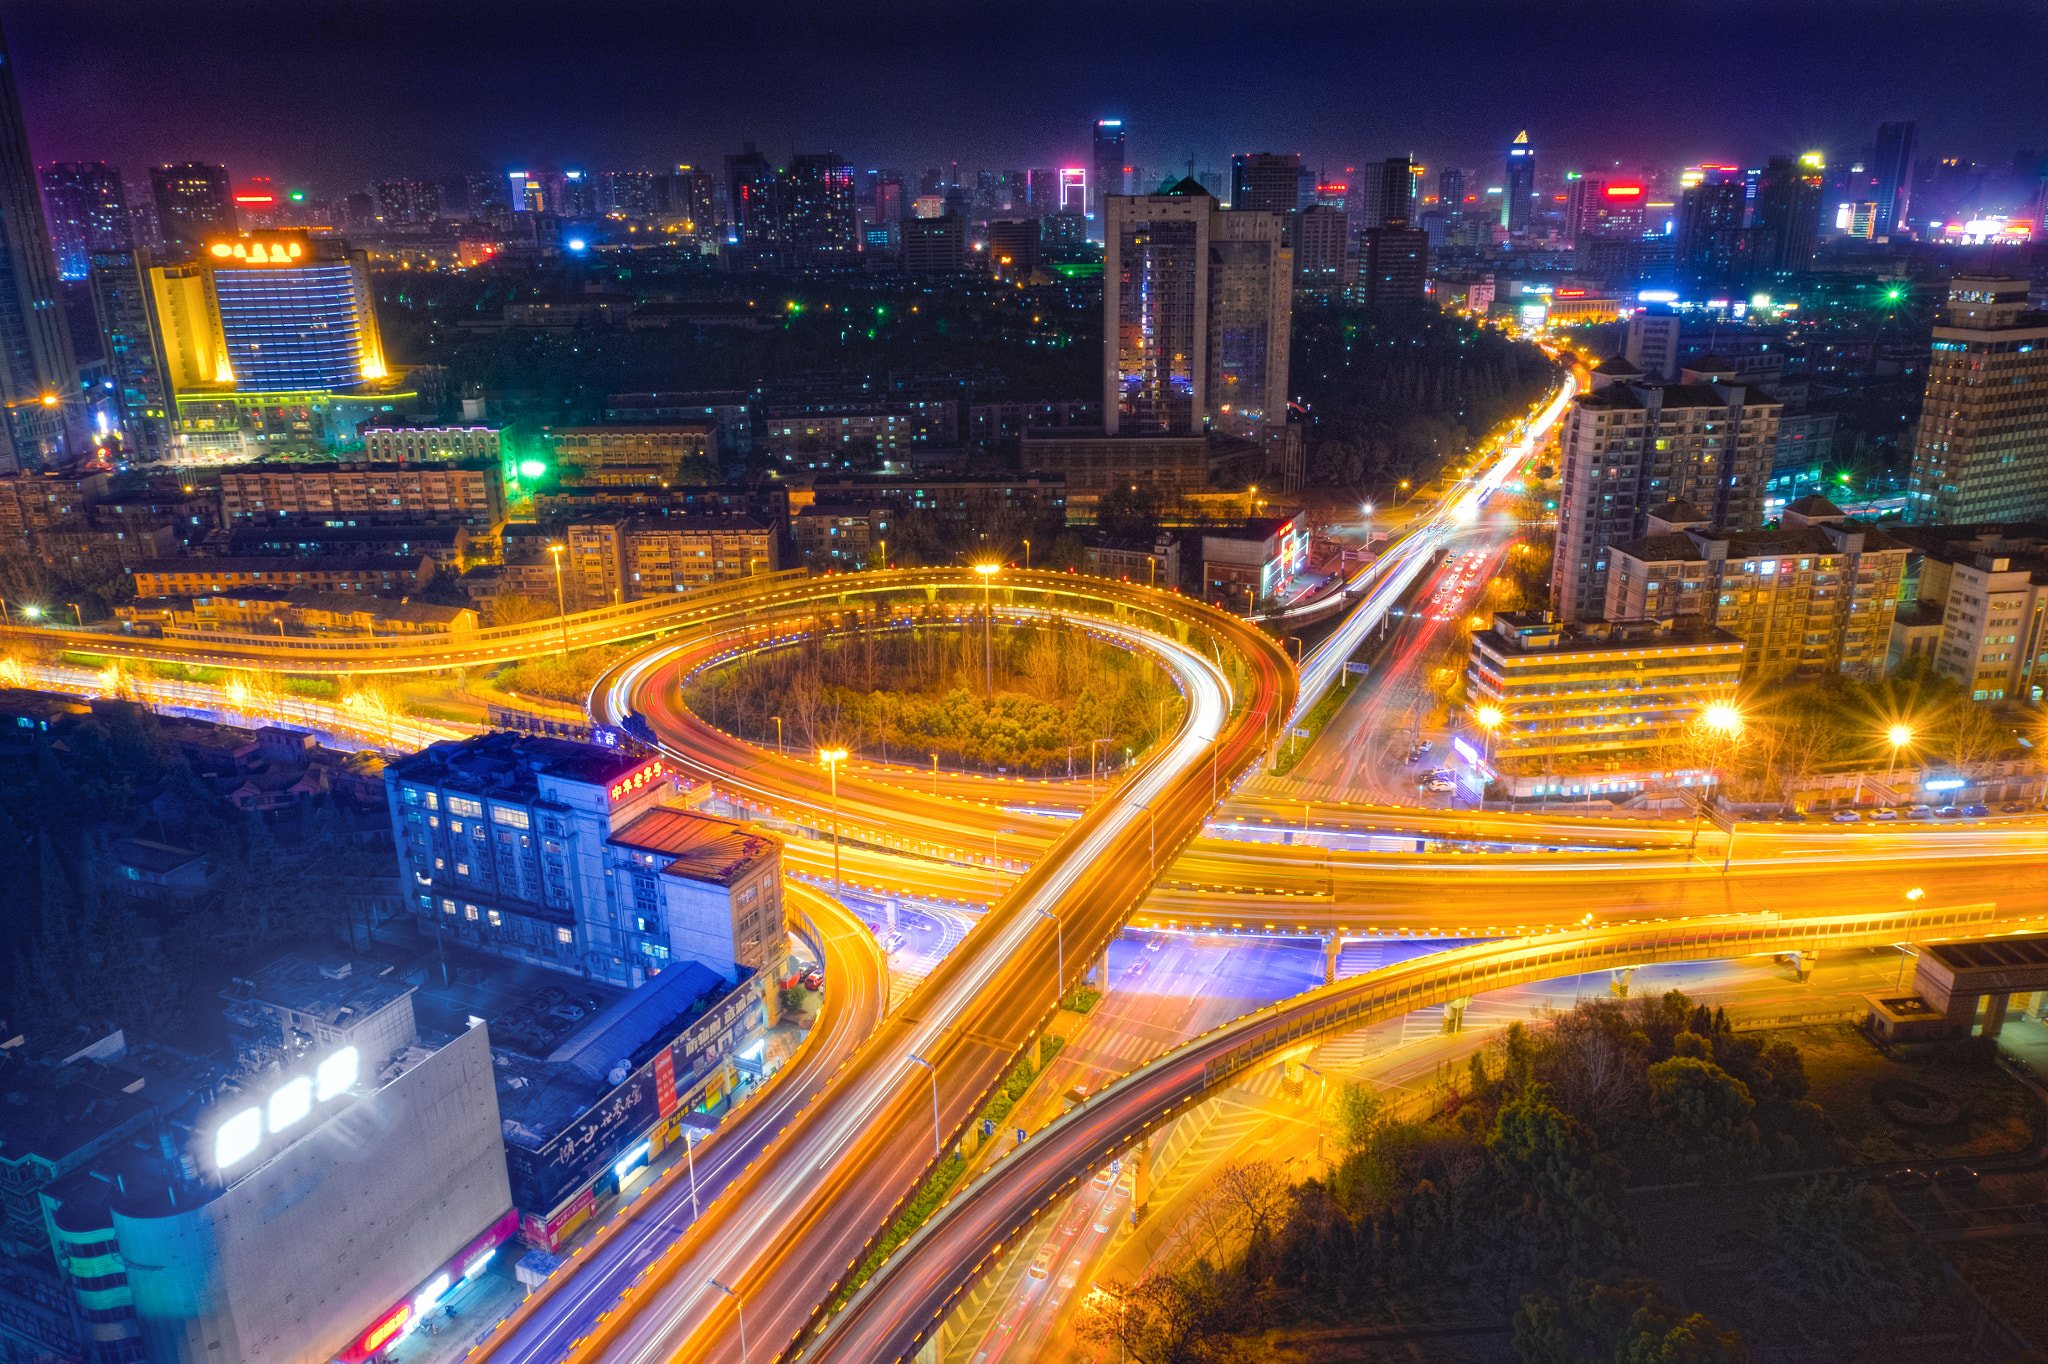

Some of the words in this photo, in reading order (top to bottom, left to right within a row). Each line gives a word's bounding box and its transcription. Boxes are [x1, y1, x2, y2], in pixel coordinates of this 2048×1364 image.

[611, 761, 662, 801] 中华老字号
